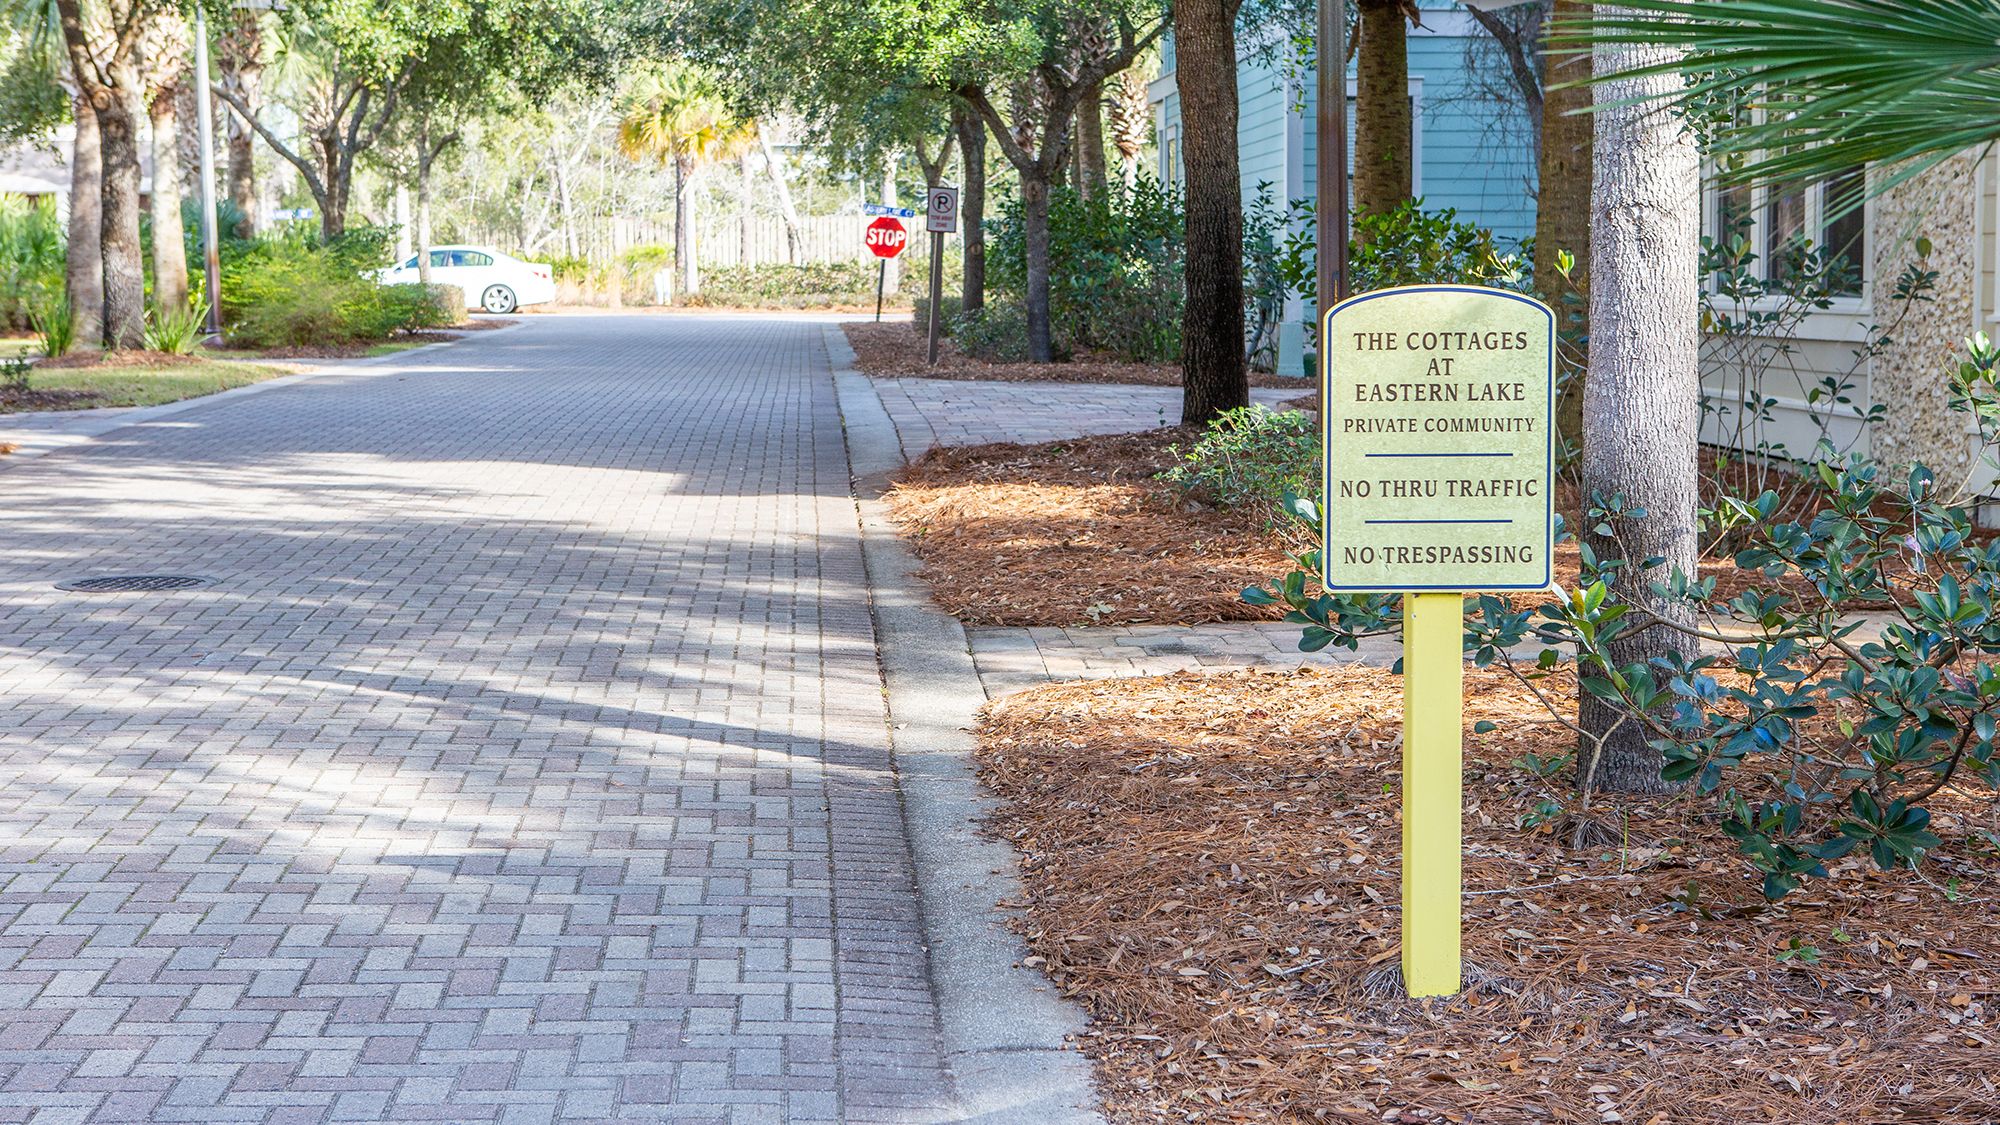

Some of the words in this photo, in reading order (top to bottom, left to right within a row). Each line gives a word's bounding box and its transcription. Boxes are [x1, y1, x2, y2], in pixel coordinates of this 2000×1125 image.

[867, 228, 906, 247] STOP
[1353, 332, 1398, 351] THE
[1406, 331, 1528, 351] COTTAGES
[1426, 357, 1455, 376] AT
[1355, 383, 1458, 402] EASTERN
[1467, 383, 1526, 402] LAKE
[1344, 418, 1418, 433] PRIVATE
[1424, 417, 1536, 433] COMMUNITY
[1340, 480, 1371, 498] NO
[1378, 479, 1438, 498] THRU
[1445, 479, 1538, 497] TRAFFIC
[1344, 546, 1375, 564] NO
[1382, 545, 1534, 564] TRESPASSING
